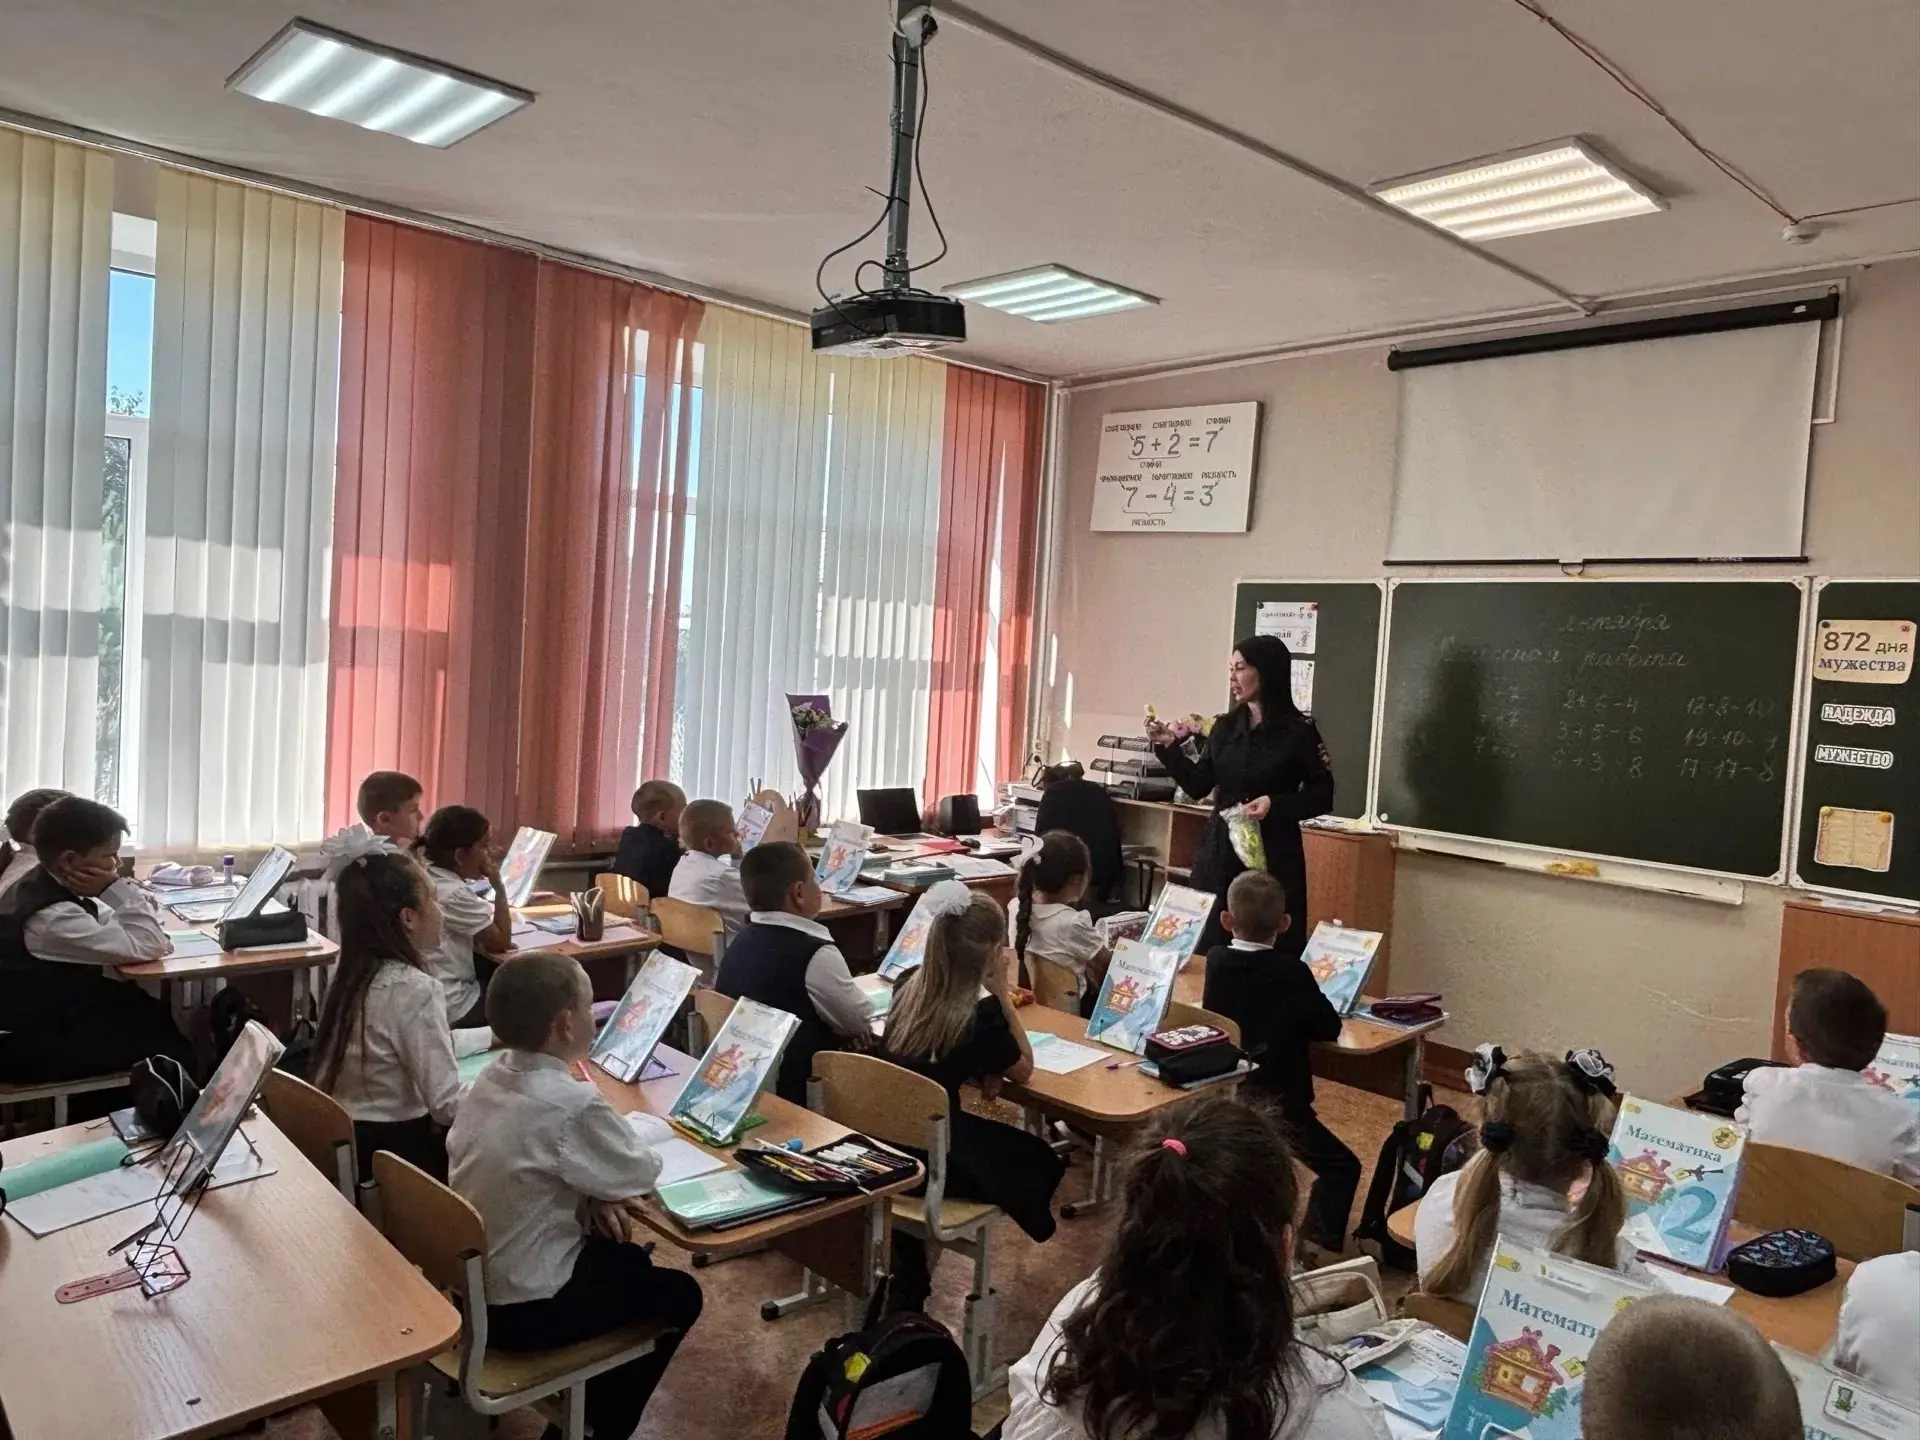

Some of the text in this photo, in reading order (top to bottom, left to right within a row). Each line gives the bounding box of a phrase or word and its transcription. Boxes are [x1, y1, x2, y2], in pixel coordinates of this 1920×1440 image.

[1132, 435, 1145, 457] 5
[1168, 432, 1181, 455] 2
[1206, 431, 1218, 453] 7
[1126, 487, 1138, 507] 7
[1200, 485, 1213, 507] 3
[1824, 631, 1908, 655] 872 дня
[1818, 656, 1906, 673] мужества
[1823, 705, 1894, 725] НАДЕЖДА
[1818, 746, 1891, 766] МУЖЕСТВО
[1626, 1124, 1723, 1163] Математика
[1664, 1186, 1718, 1245] 2
